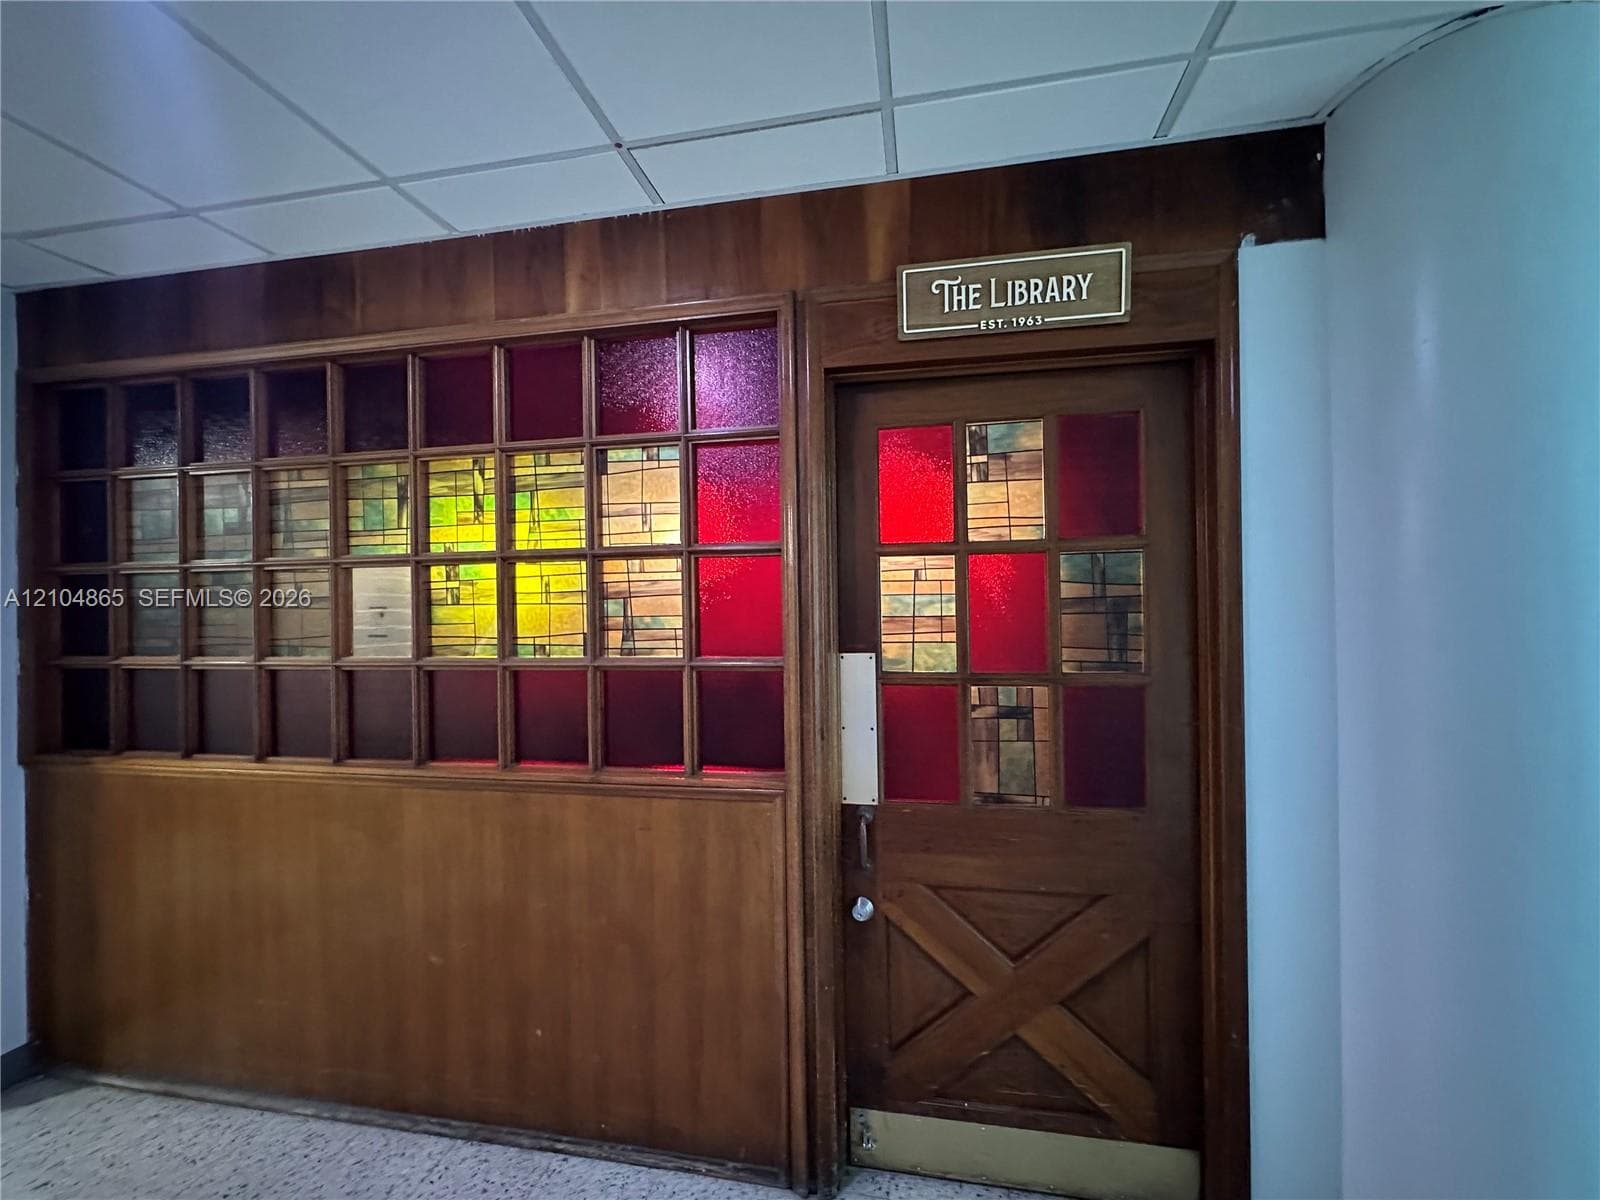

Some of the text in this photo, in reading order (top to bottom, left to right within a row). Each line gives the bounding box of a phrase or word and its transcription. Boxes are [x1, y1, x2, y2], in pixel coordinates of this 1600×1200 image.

[931, 272, 1095, 314] THE LIBRARY
[979, 315, 1043, 330] EST. 1963
